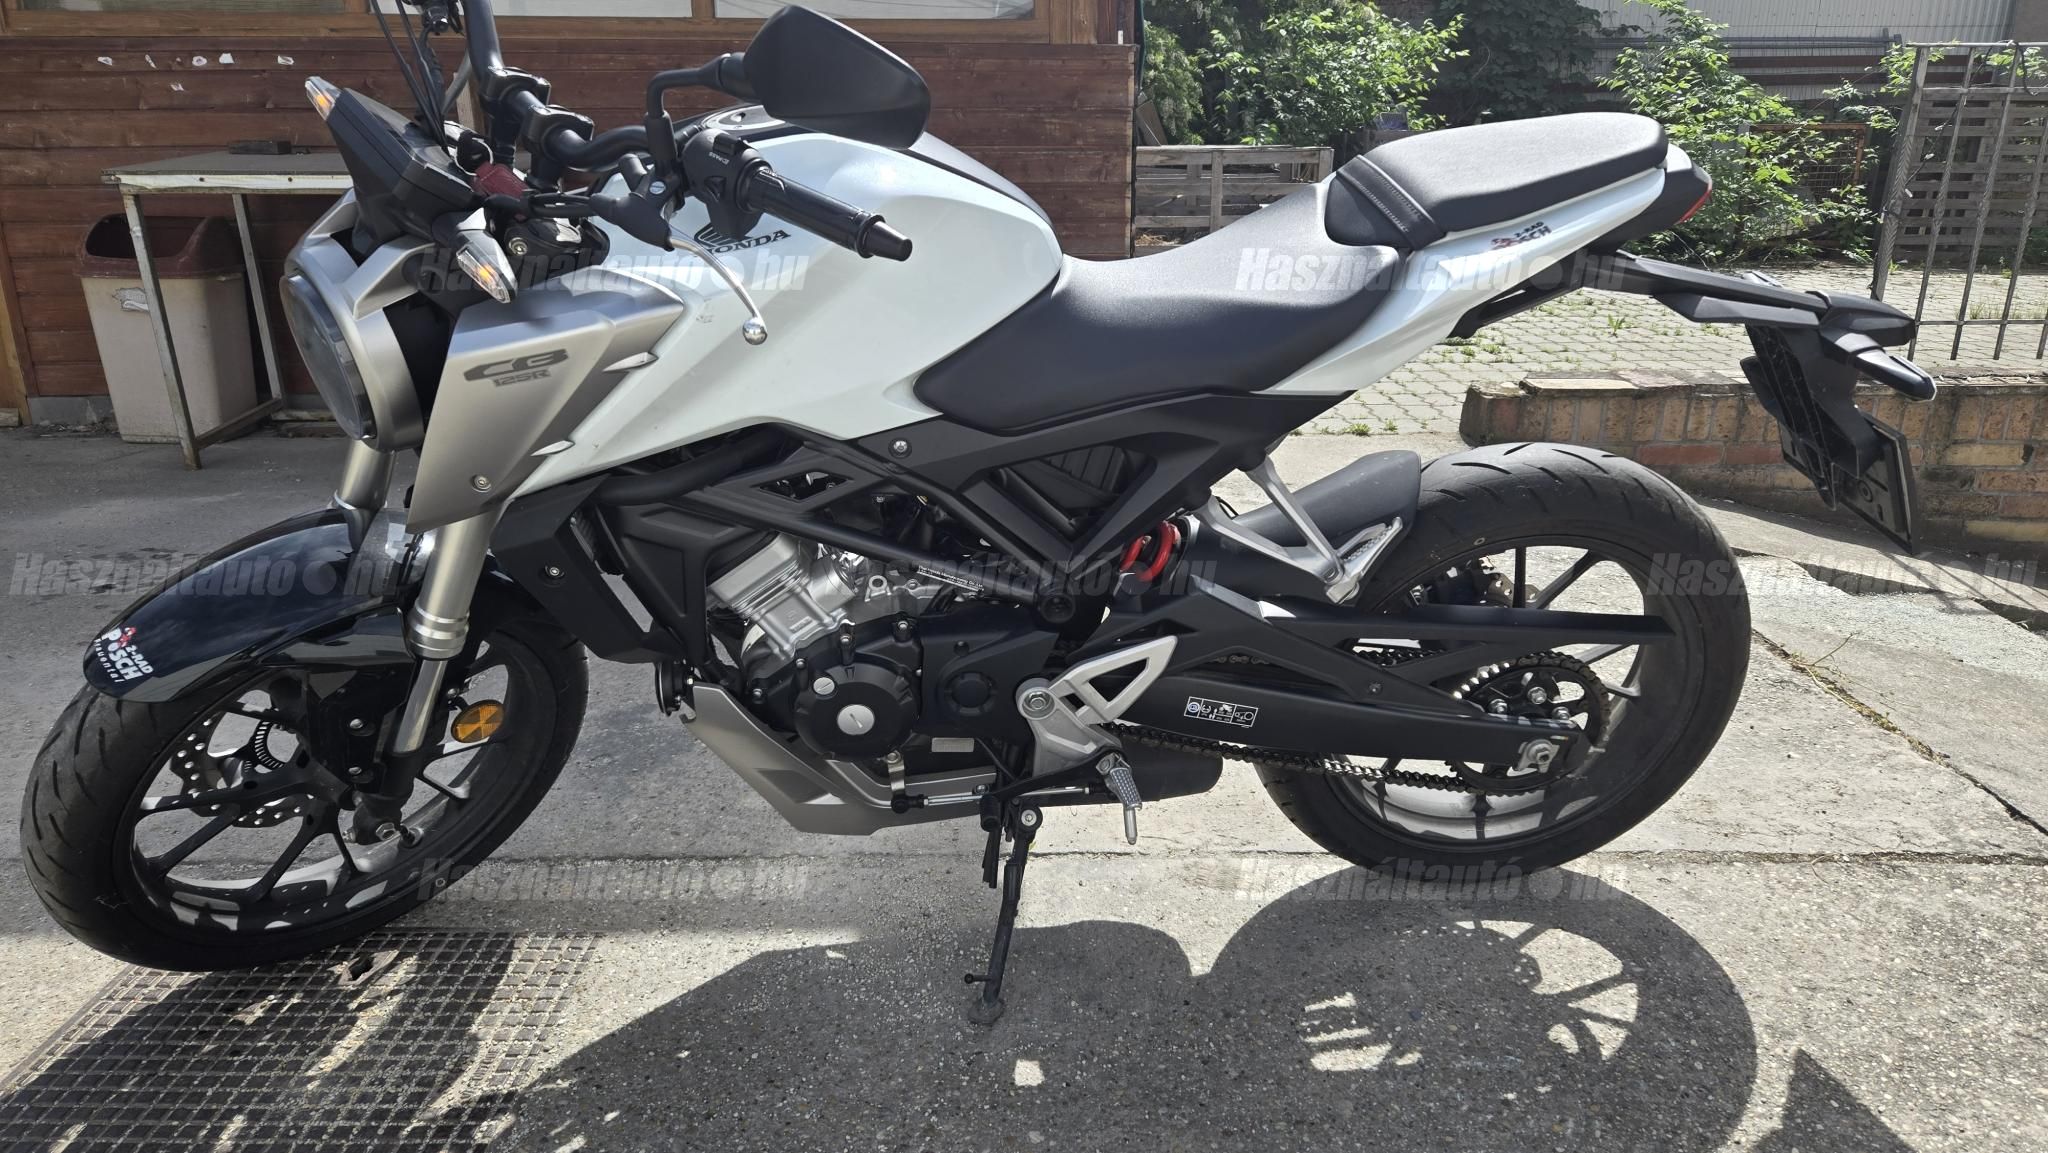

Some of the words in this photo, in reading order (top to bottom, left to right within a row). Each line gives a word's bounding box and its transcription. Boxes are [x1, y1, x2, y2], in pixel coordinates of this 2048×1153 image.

[463, 348, 569, 382] CB
[493, 369, 552, 388] 125R
[101, 627, 144, 680] POSCH
[125, 645, 154, 674] 2-RAD
